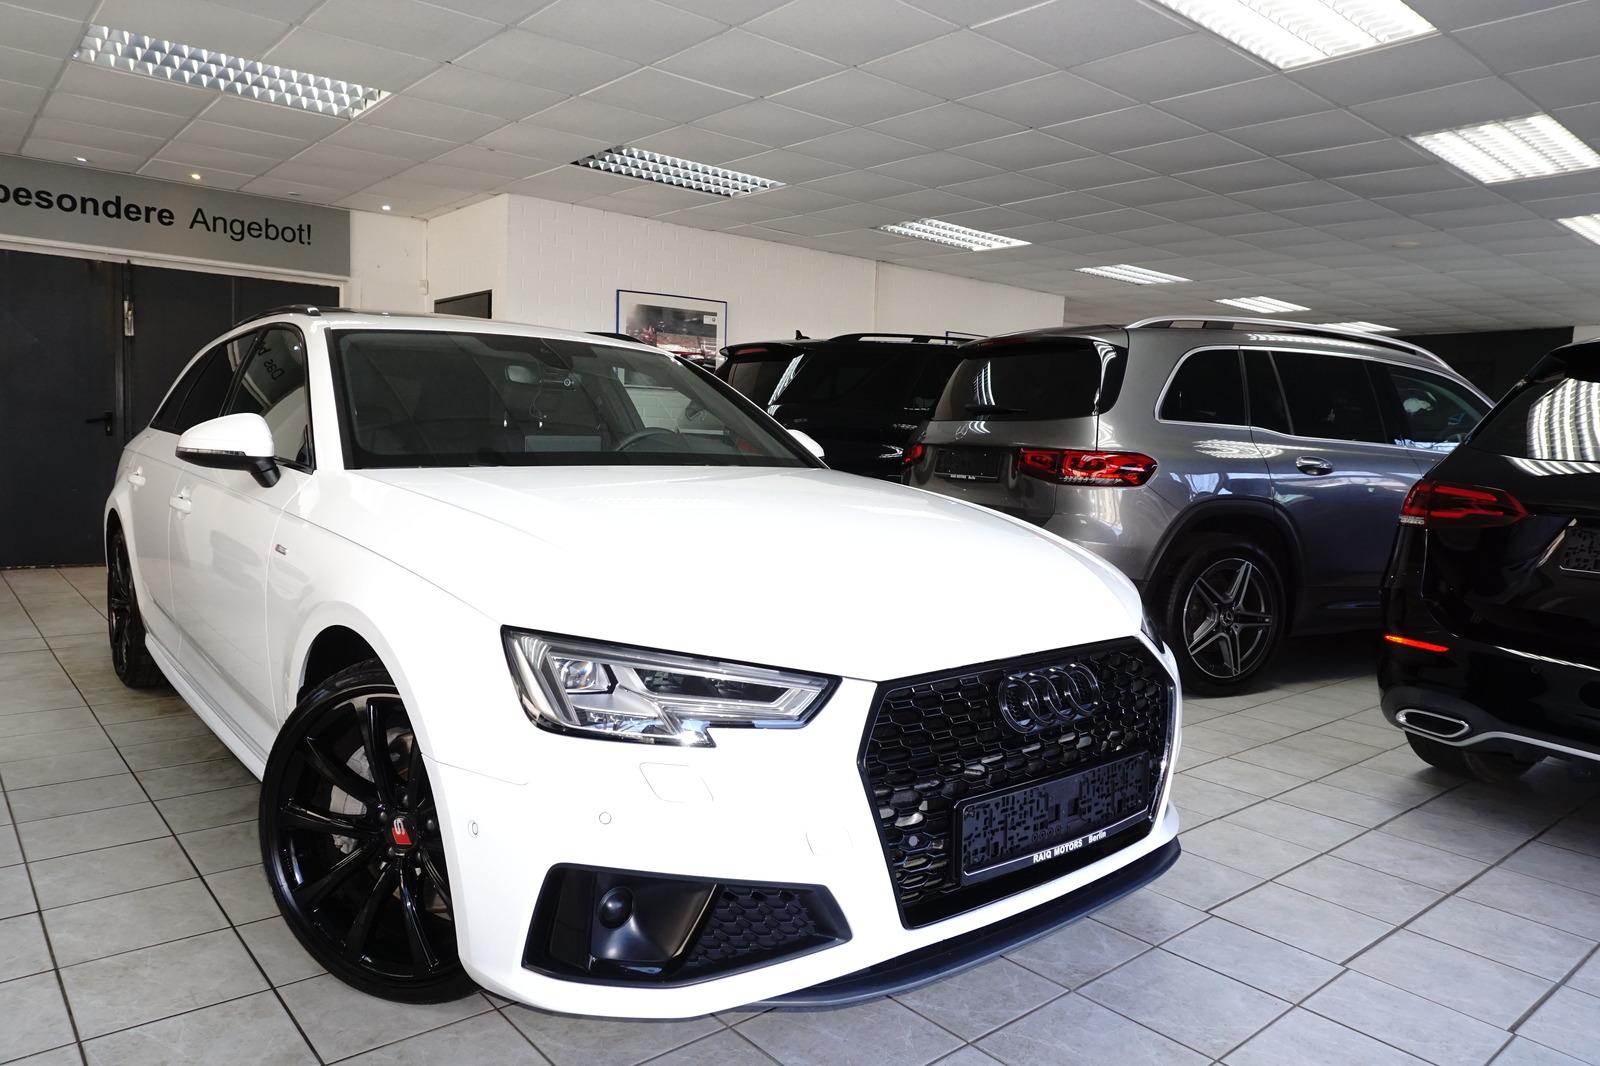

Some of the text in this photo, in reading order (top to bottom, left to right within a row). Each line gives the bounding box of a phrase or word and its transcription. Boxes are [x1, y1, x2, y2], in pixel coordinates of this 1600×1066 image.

[189, 208, 312, 245] Angebot!
[1053, 840, 1083, 856] MOTORS
[1089, 831, 1106, 844] Berlin
